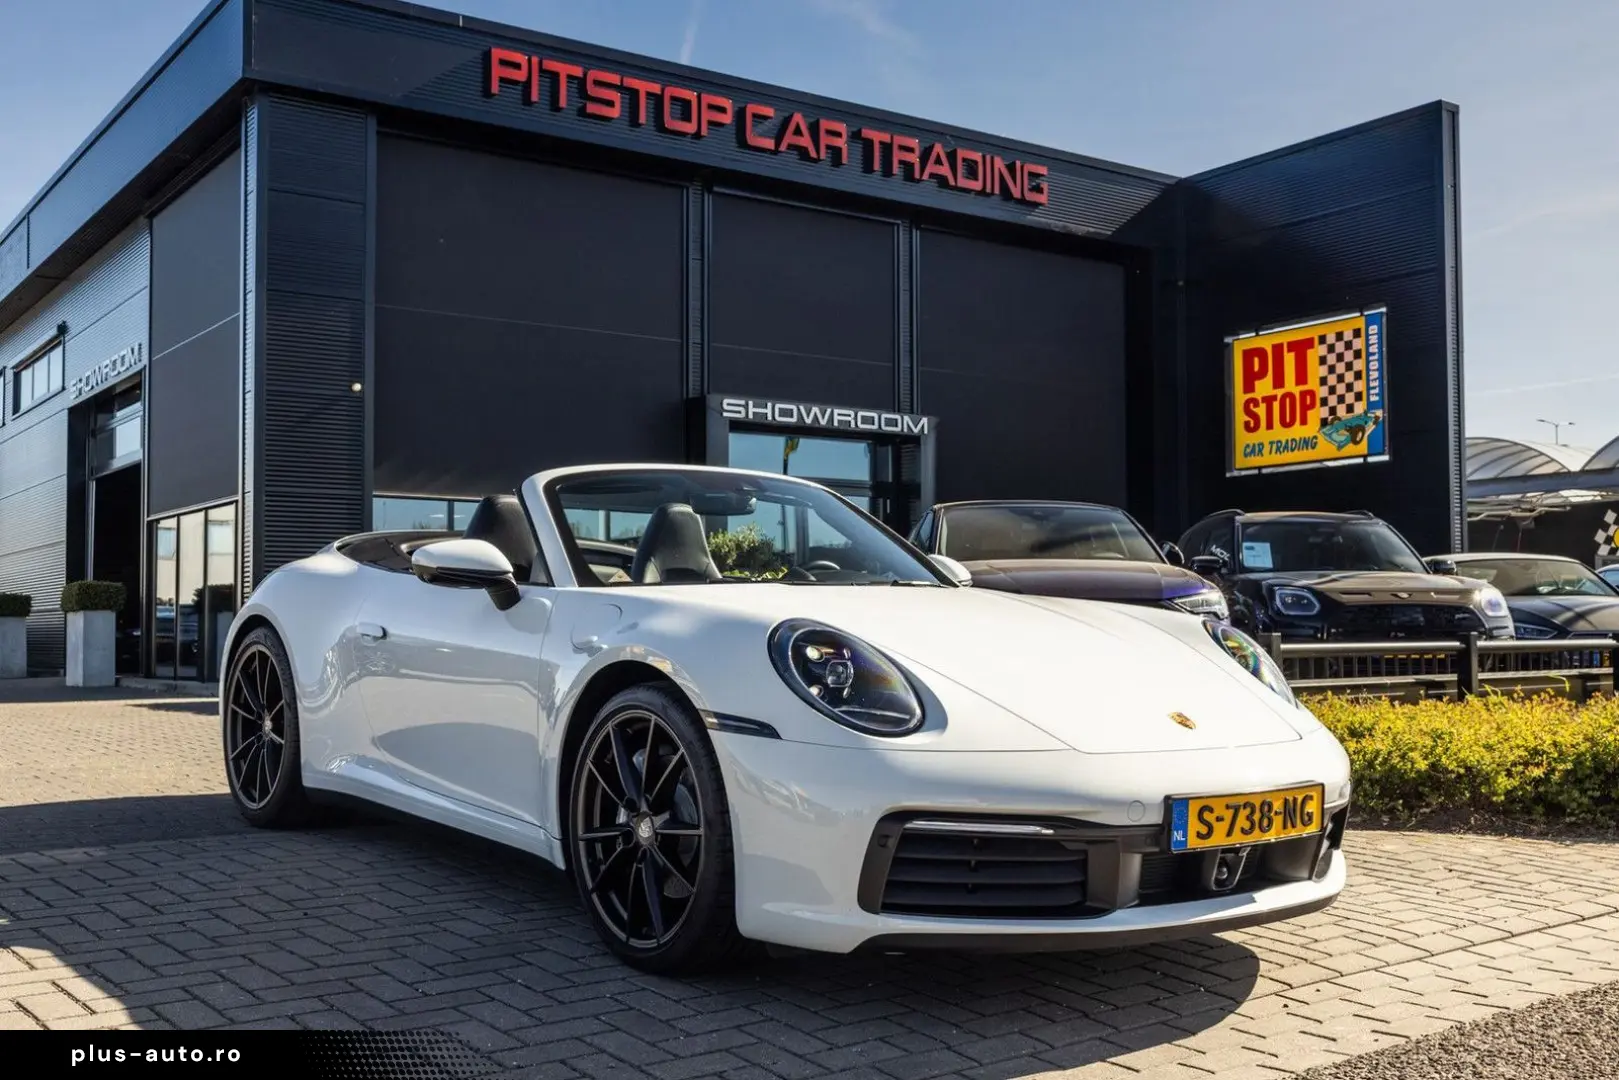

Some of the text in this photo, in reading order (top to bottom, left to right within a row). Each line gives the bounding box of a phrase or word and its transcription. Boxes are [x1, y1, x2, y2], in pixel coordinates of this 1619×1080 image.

[490, 46, 1049, 205] PITSTOP CAR TRADING
[1242, 336, 1315, 394] PIT
[1368, 324, 1380, 402] FLEVOLAND
[721, 398, 929, 435] SHOWROOM
[1242, 388, 1318, 434] STOP
[1242, 434, 1319, 459] CAR TRADING
[1173, 830, 1187, 841] NL
[1196, 793, 1315, 841] S-738-NG
